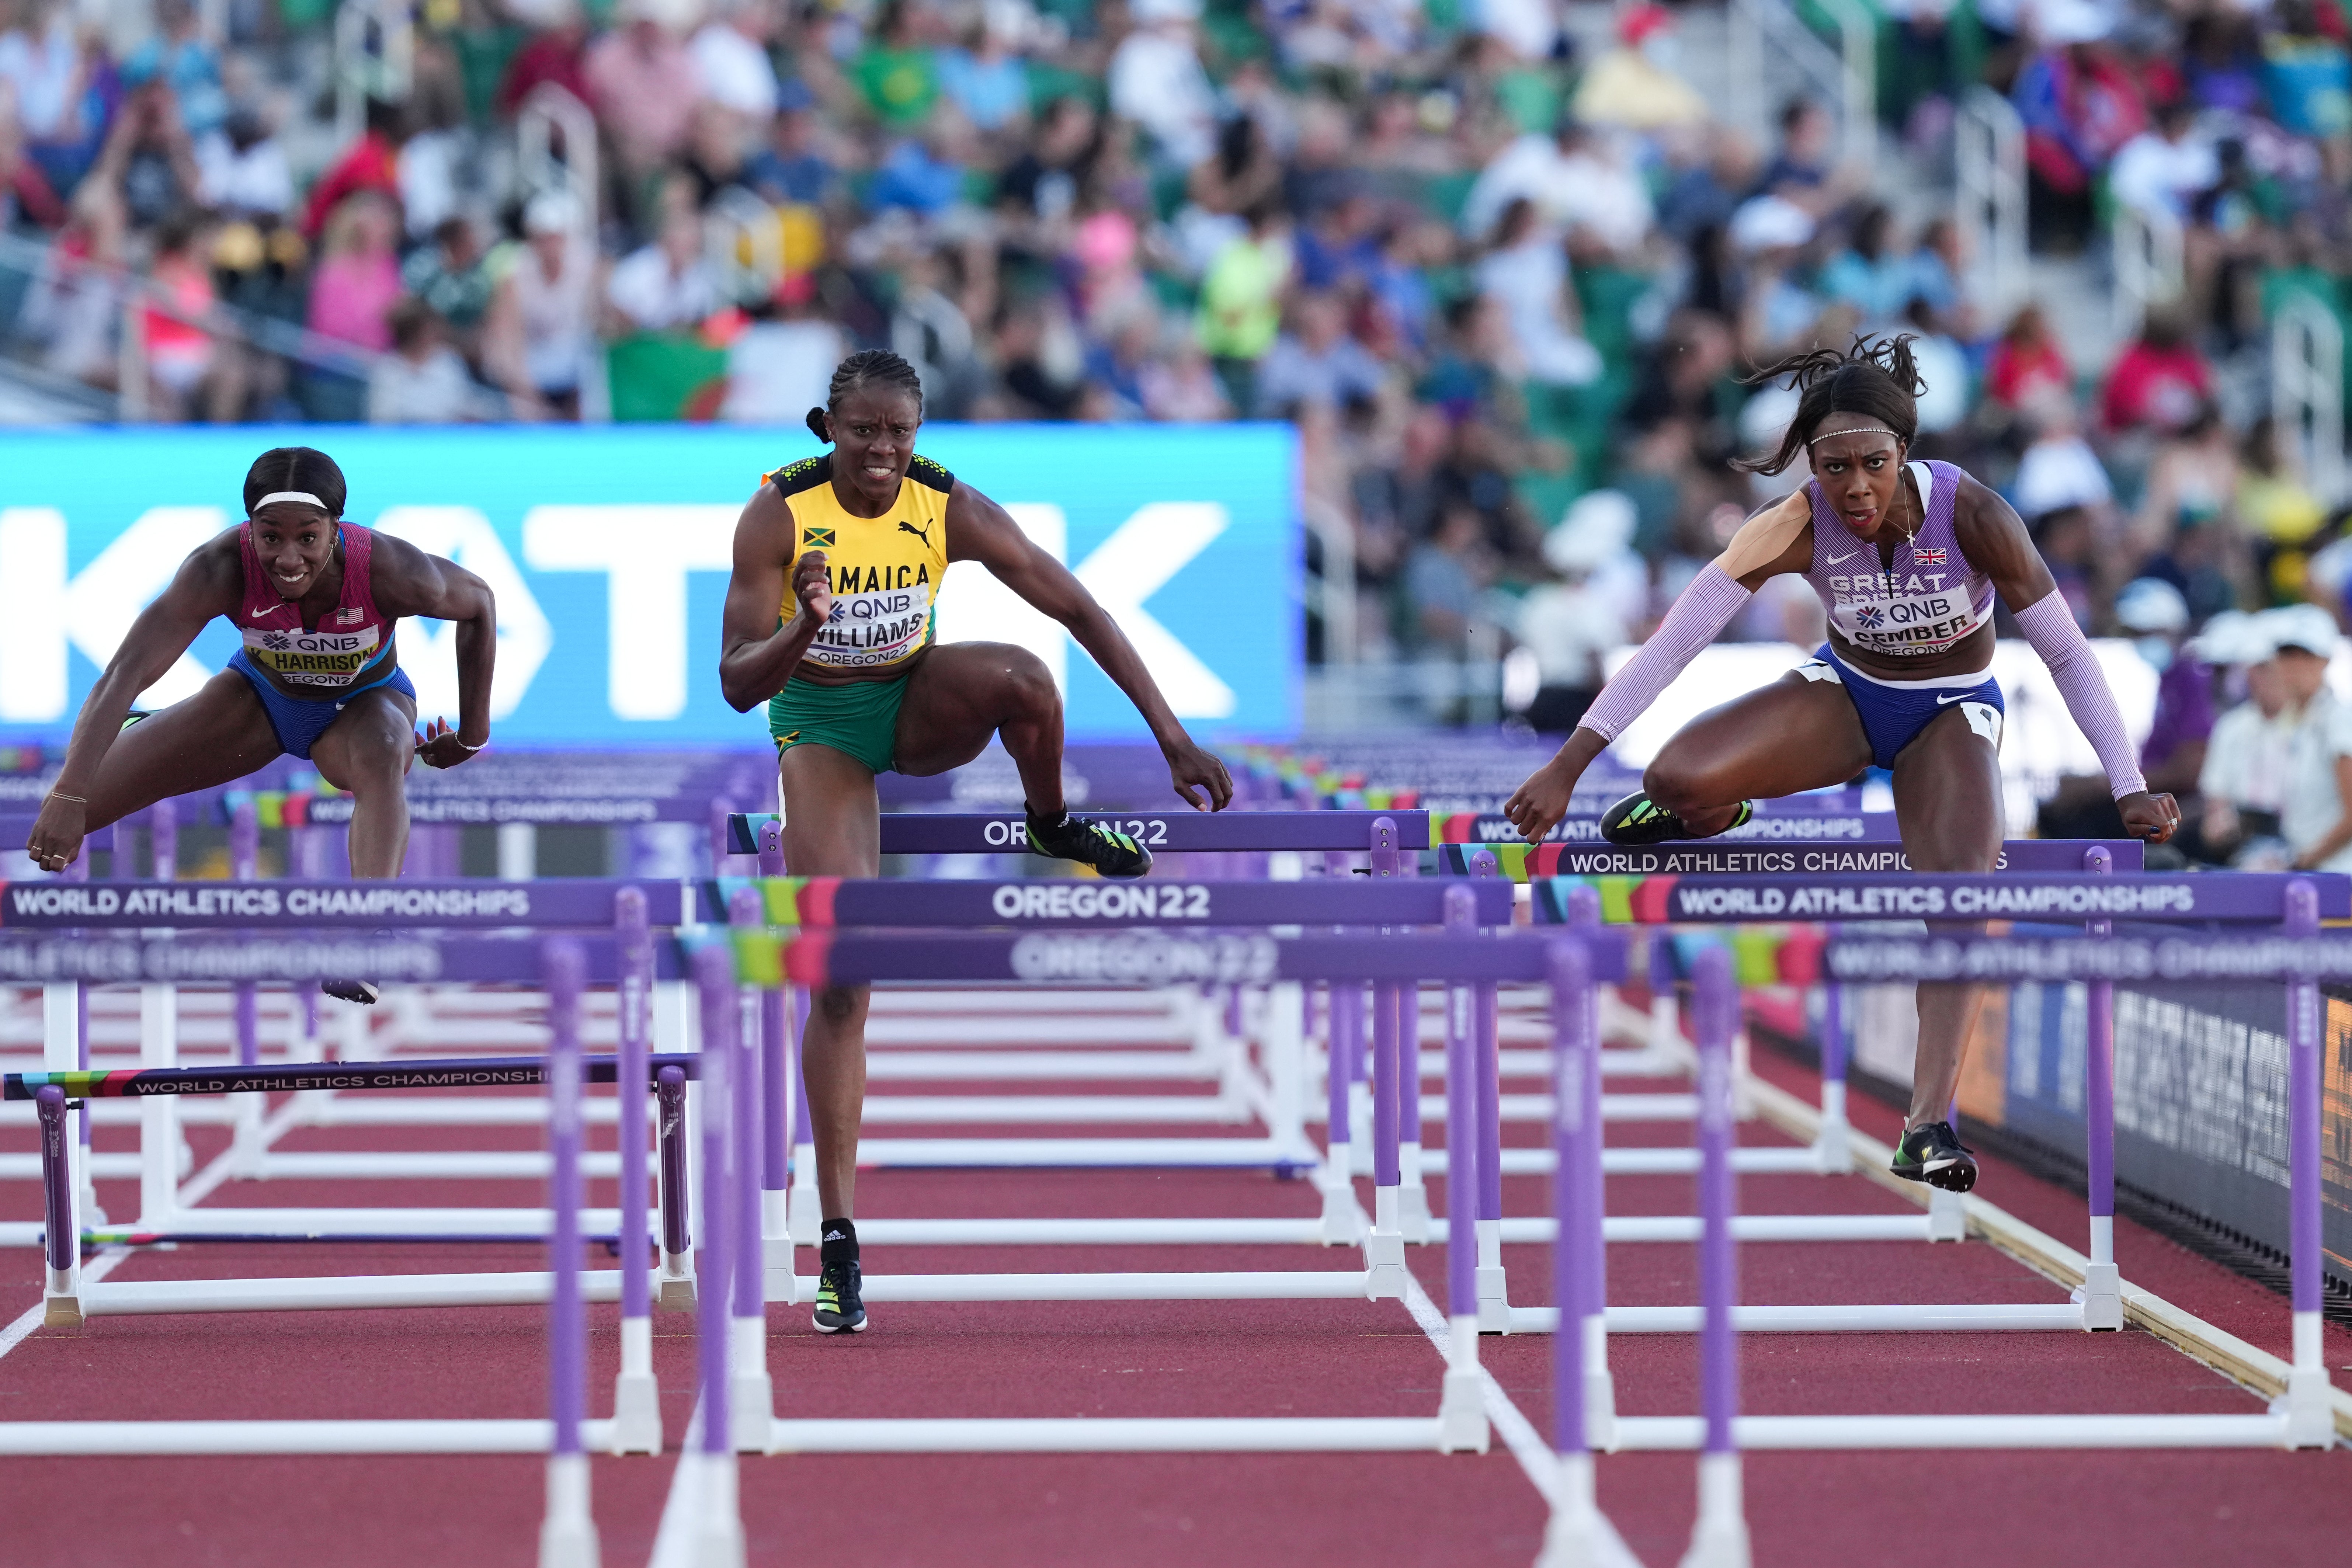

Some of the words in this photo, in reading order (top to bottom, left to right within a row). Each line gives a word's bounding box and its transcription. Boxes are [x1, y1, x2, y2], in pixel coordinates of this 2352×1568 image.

[824, 563, 929, 594] AMAICA
[1829, 573, 1946, 591] GREAT
[851, 594, 910, 620] QNB
[1889, 598, 1950, 623] QNB
[297, 637, 359, 651] QNB
[818, 644, 908, 665] OREGON22
[274, 646, 373, 670] HARRISON
[283, 672, 356, 685] REGON2
[984, 820, 1167, 845] OR22
[1570, 853, 1658, 872] WORLD
[1664, 852, 1796, 872] ATHLETICS
[1804, 851, 2008, 871] CHAMPIOS
[12, 889, 121, 916] WORLD
[124, 888, 282, 916] ATHLETICS
[286, 889, 531, 917] CHAMPIONSHIPS
[992, 885, 1211, 918] OREGON22
[1678, 887, 1785, 914] WORLD
[1788, 886, 1946, 914] ATHLETICS
[1951, 885, 2195, 913] CHAMPIONSHIPS
[136, 1081, 225, 1094] WORLD
[232, 1076, 365, 1091] ATHLETICS
[373, 1070, 550, 1087] CHAMPIONSHI
